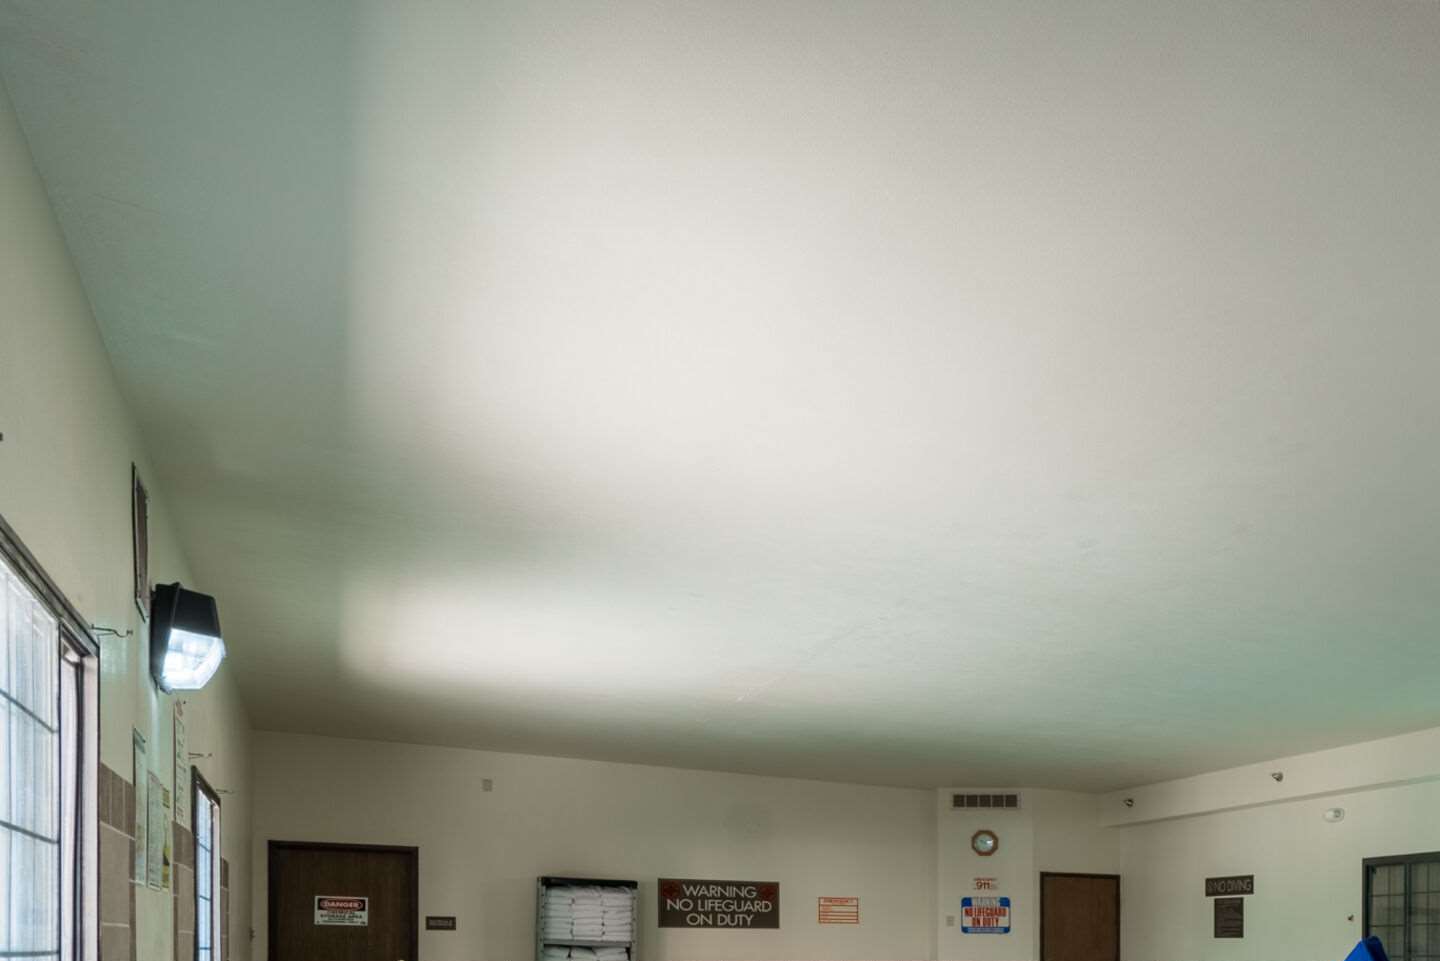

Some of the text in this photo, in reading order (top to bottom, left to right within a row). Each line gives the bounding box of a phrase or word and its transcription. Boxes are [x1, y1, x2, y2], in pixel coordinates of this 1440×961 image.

[683, 884, 757, 898] WARNING
[666, 898, 772, 913] NO LIFEGUARD
[686, 913, 754, 926] ON DUTY
